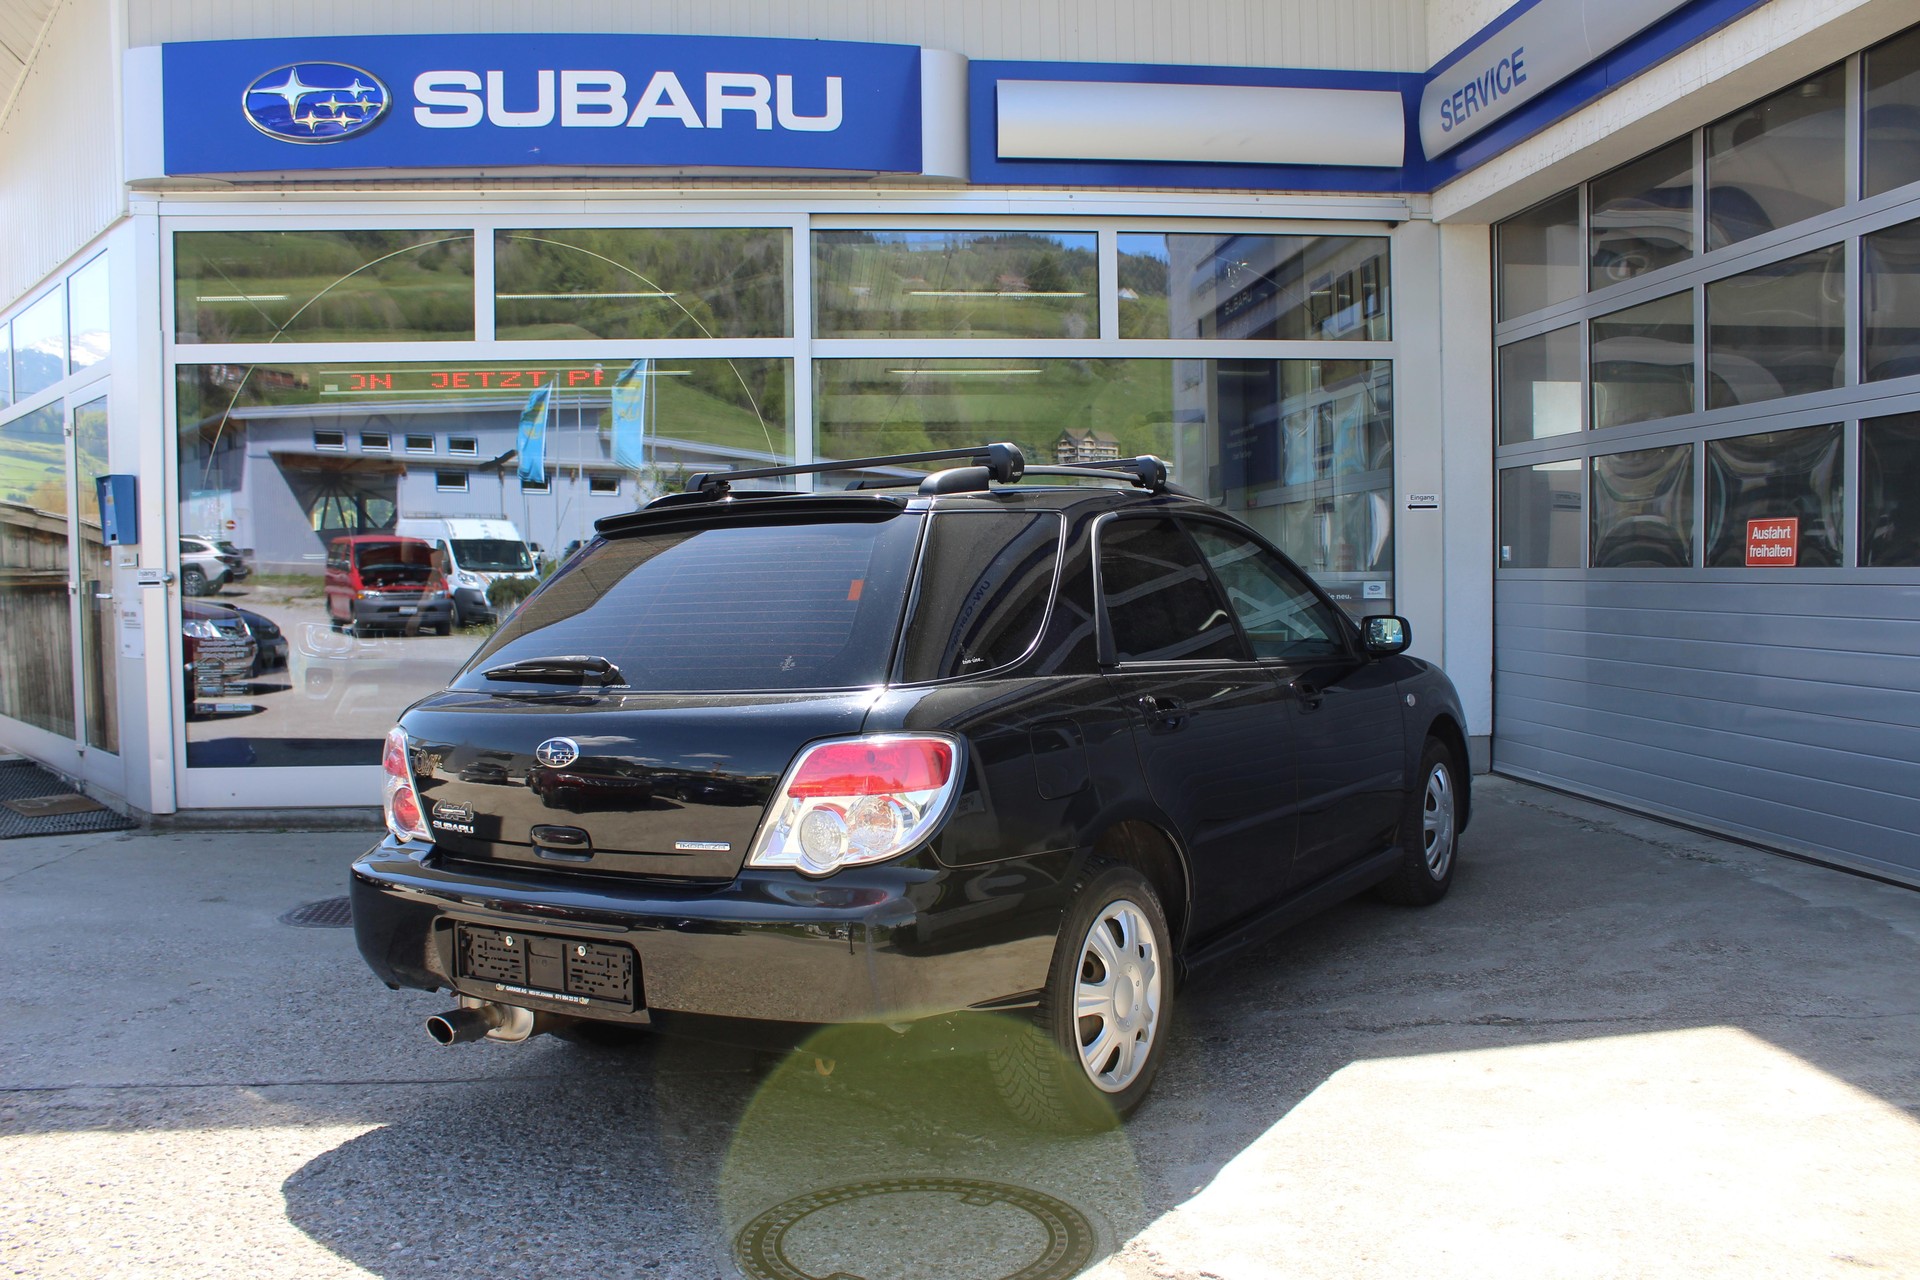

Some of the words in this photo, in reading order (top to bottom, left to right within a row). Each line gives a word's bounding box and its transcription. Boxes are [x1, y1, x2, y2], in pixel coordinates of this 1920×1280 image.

[1440, 46, 1527, 132] SERVICE
[413, 70, 843, 131] SUBARU
[431, 371, 547, 389] JETZT
[1752, 525, 1791, 540] Ausfahrt
[1749, 544, 1792, 558] freihalten
[432, 798, 474, 822] 4x4
[432, 820, 474, 834] SUBARU
